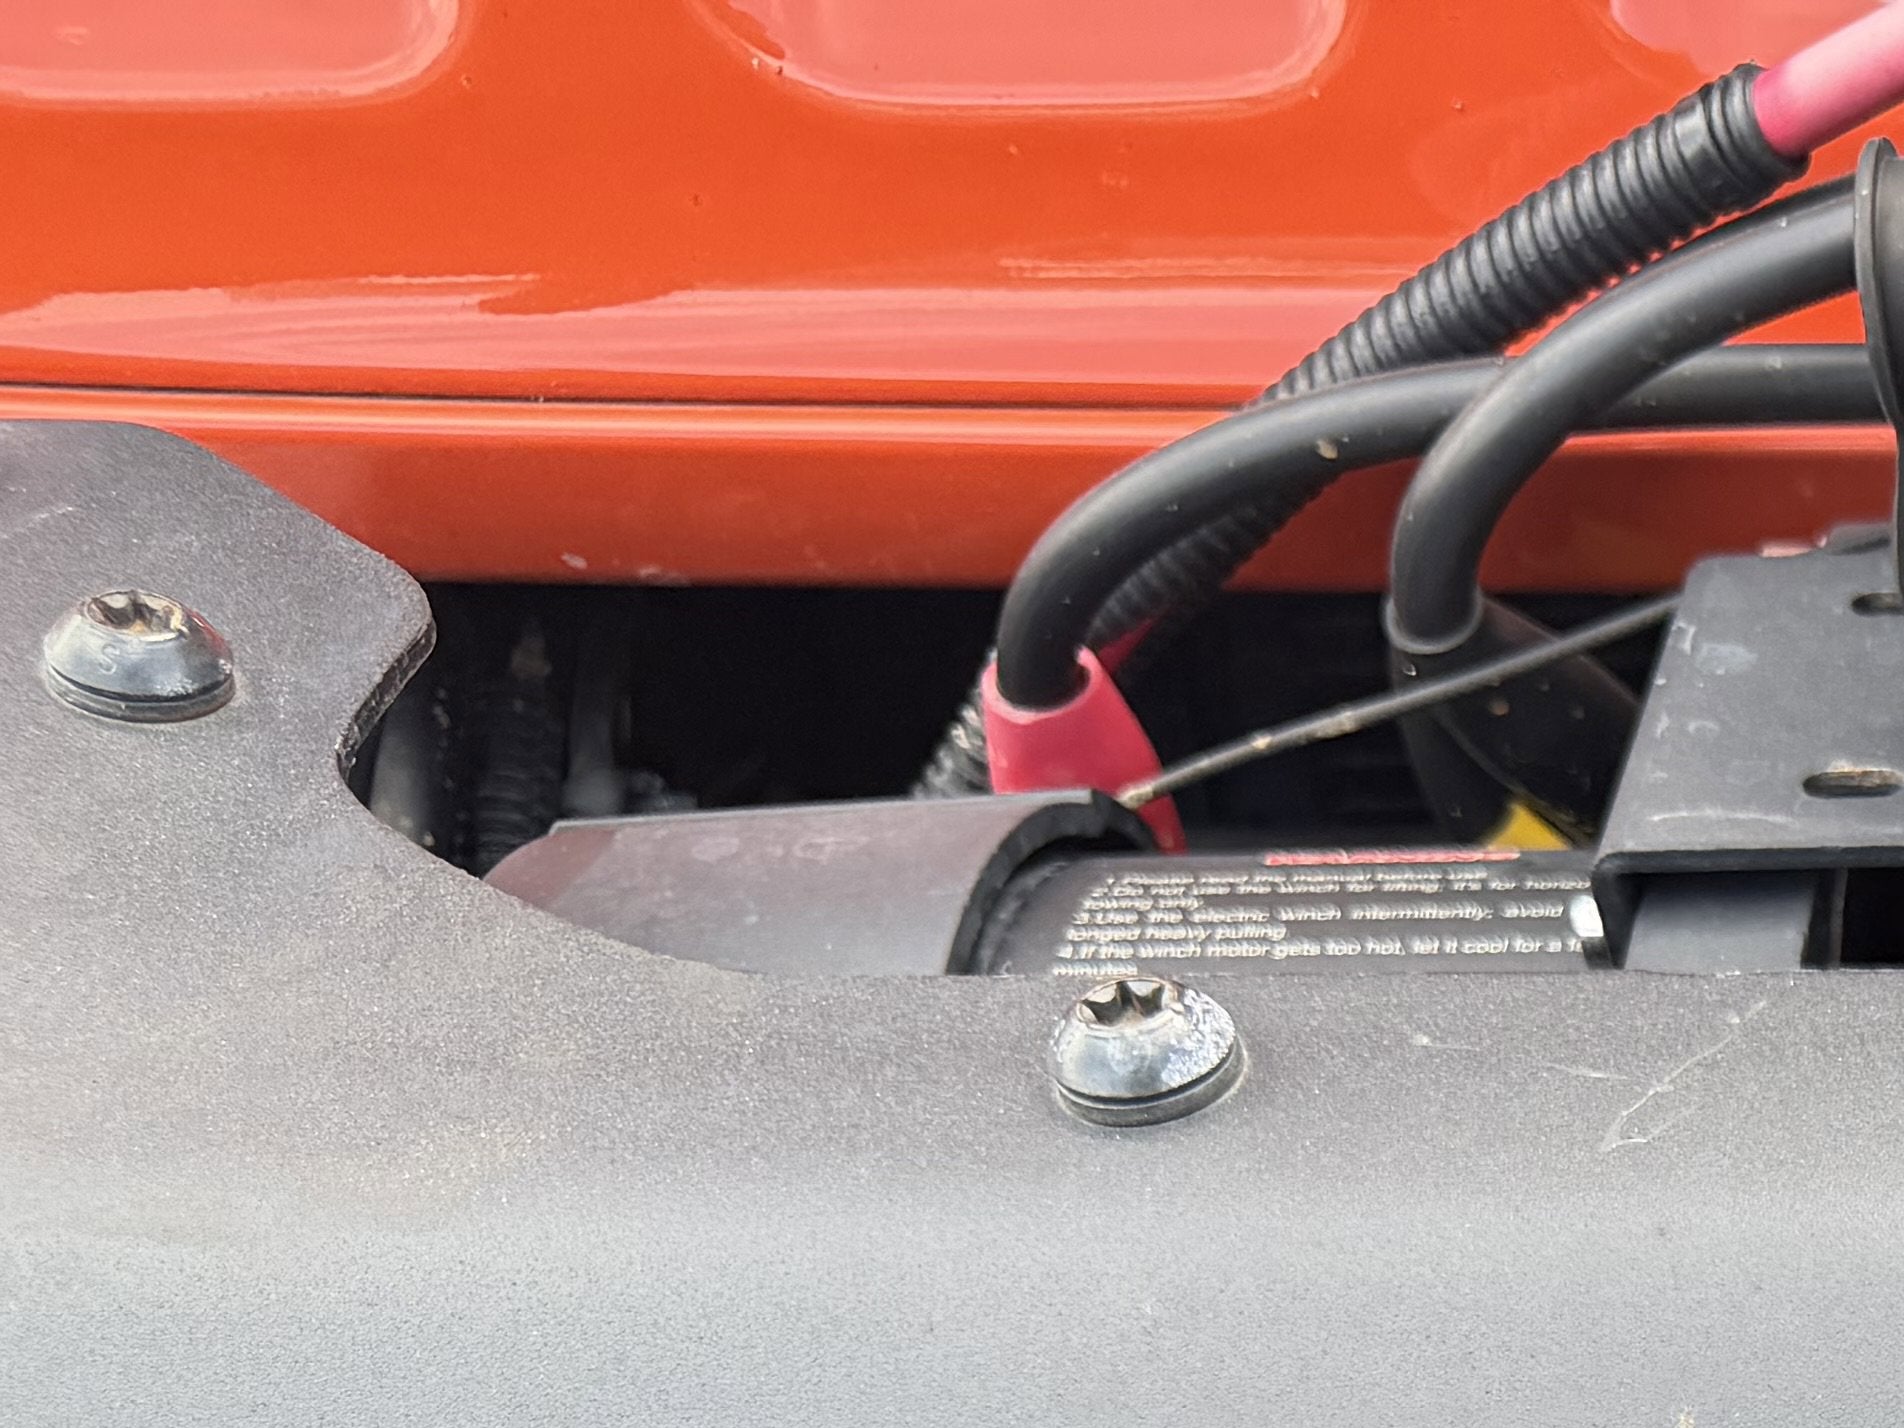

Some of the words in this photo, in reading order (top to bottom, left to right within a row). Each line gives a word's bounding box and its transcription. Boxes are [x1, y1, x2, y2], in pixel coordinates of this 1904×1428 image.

[1141, 908, 1183, 924] the
[1185, 905, 1270, 923] electric
[1499, 899, 1564, 918] avoid
[1143, 922, 1212, 941] heavy
[1213, 921, 1287, 941] pulling
[1097, 940, 1135, 959] the
[1203, 938, 1271, 957] motor
[1267, 938, 1320, 960] gets
[1321, 936, 1362, 955] too
[1410, 934, 1441, 954] let
[1442, 934, 1459, 954] it
[1458, 934, 1509, 953] cool
[1510, 933, 1544, 952] for
